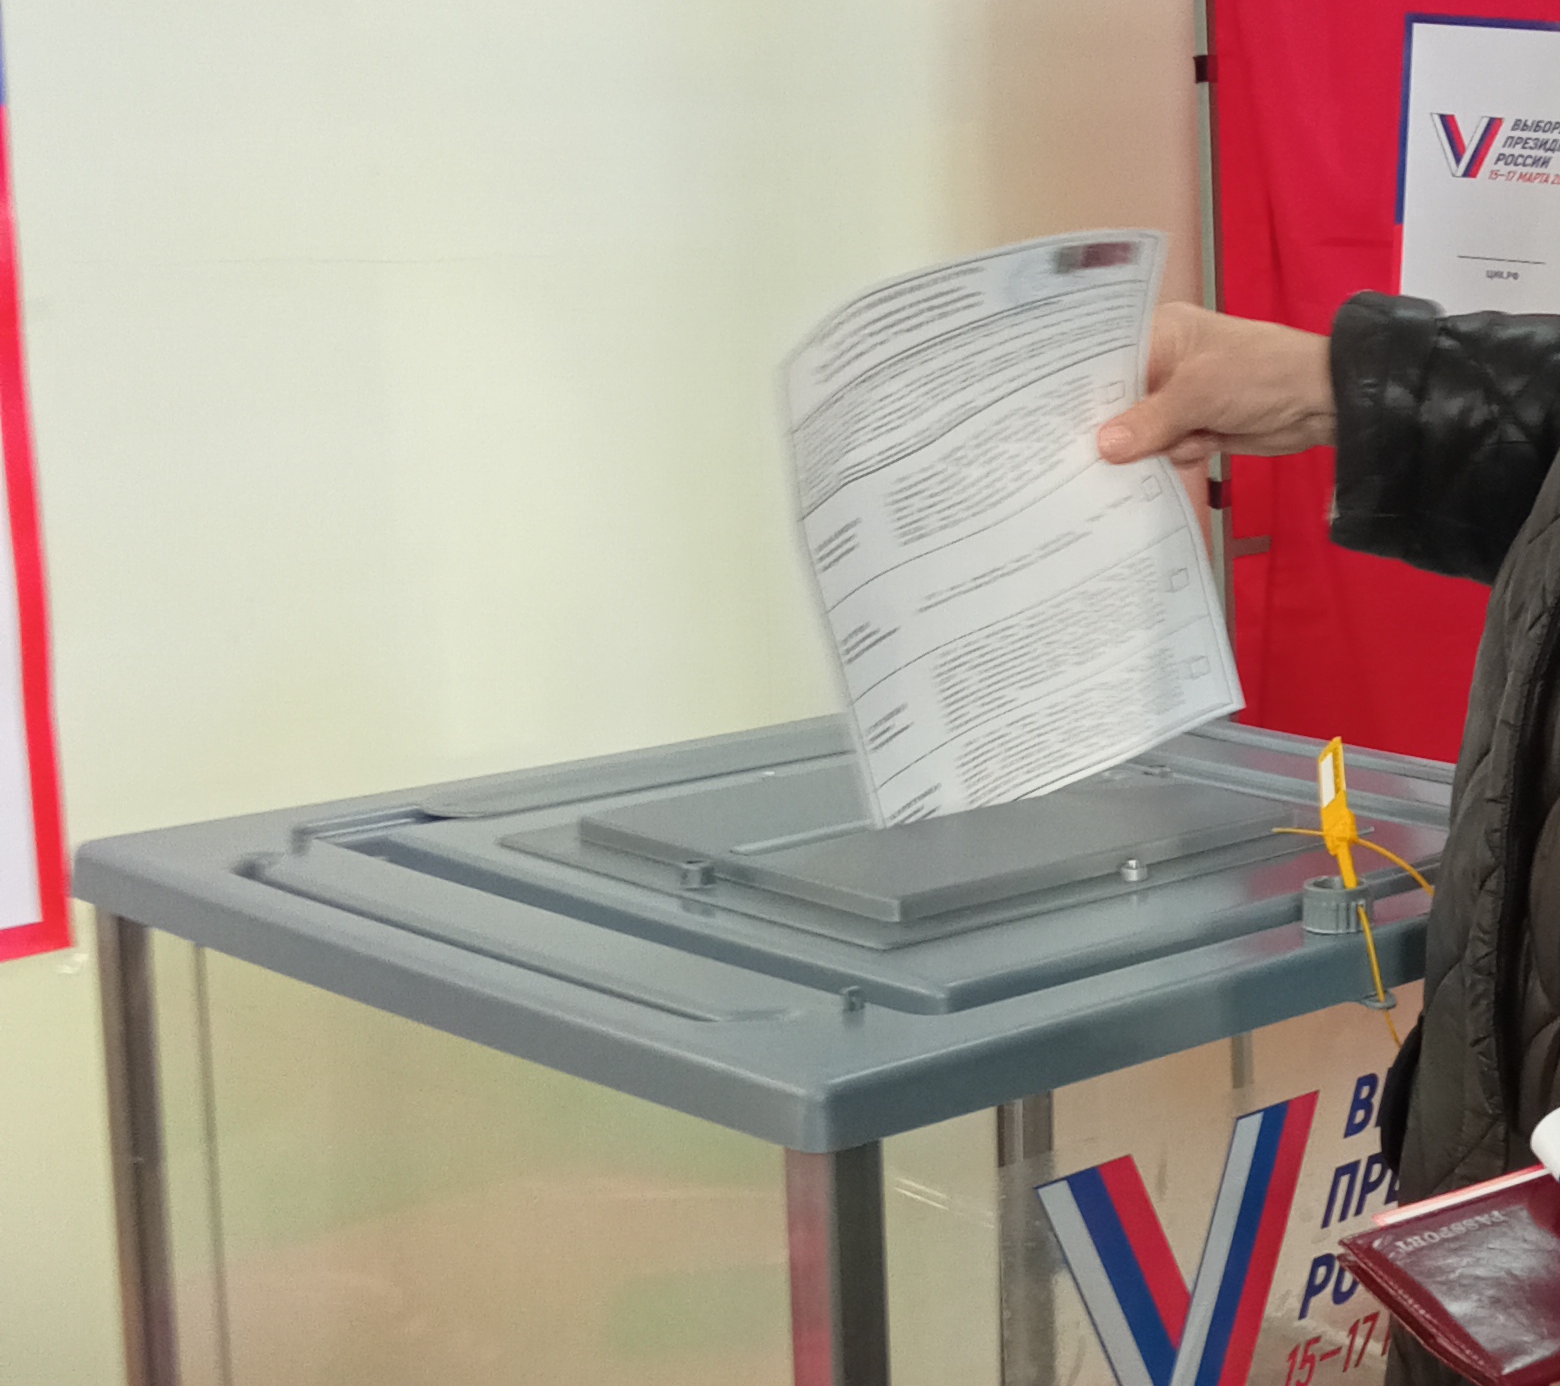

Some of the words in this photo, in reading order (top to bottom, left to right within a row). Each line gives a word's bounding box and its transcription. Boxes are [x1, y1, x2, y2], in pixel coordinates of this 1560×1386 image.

[1494, 153, 1552, 168] РОССИИ
[1517, 172, 1550, 184] МАРТА
[1394, 1209, 1508, 1254] PASSPORT
